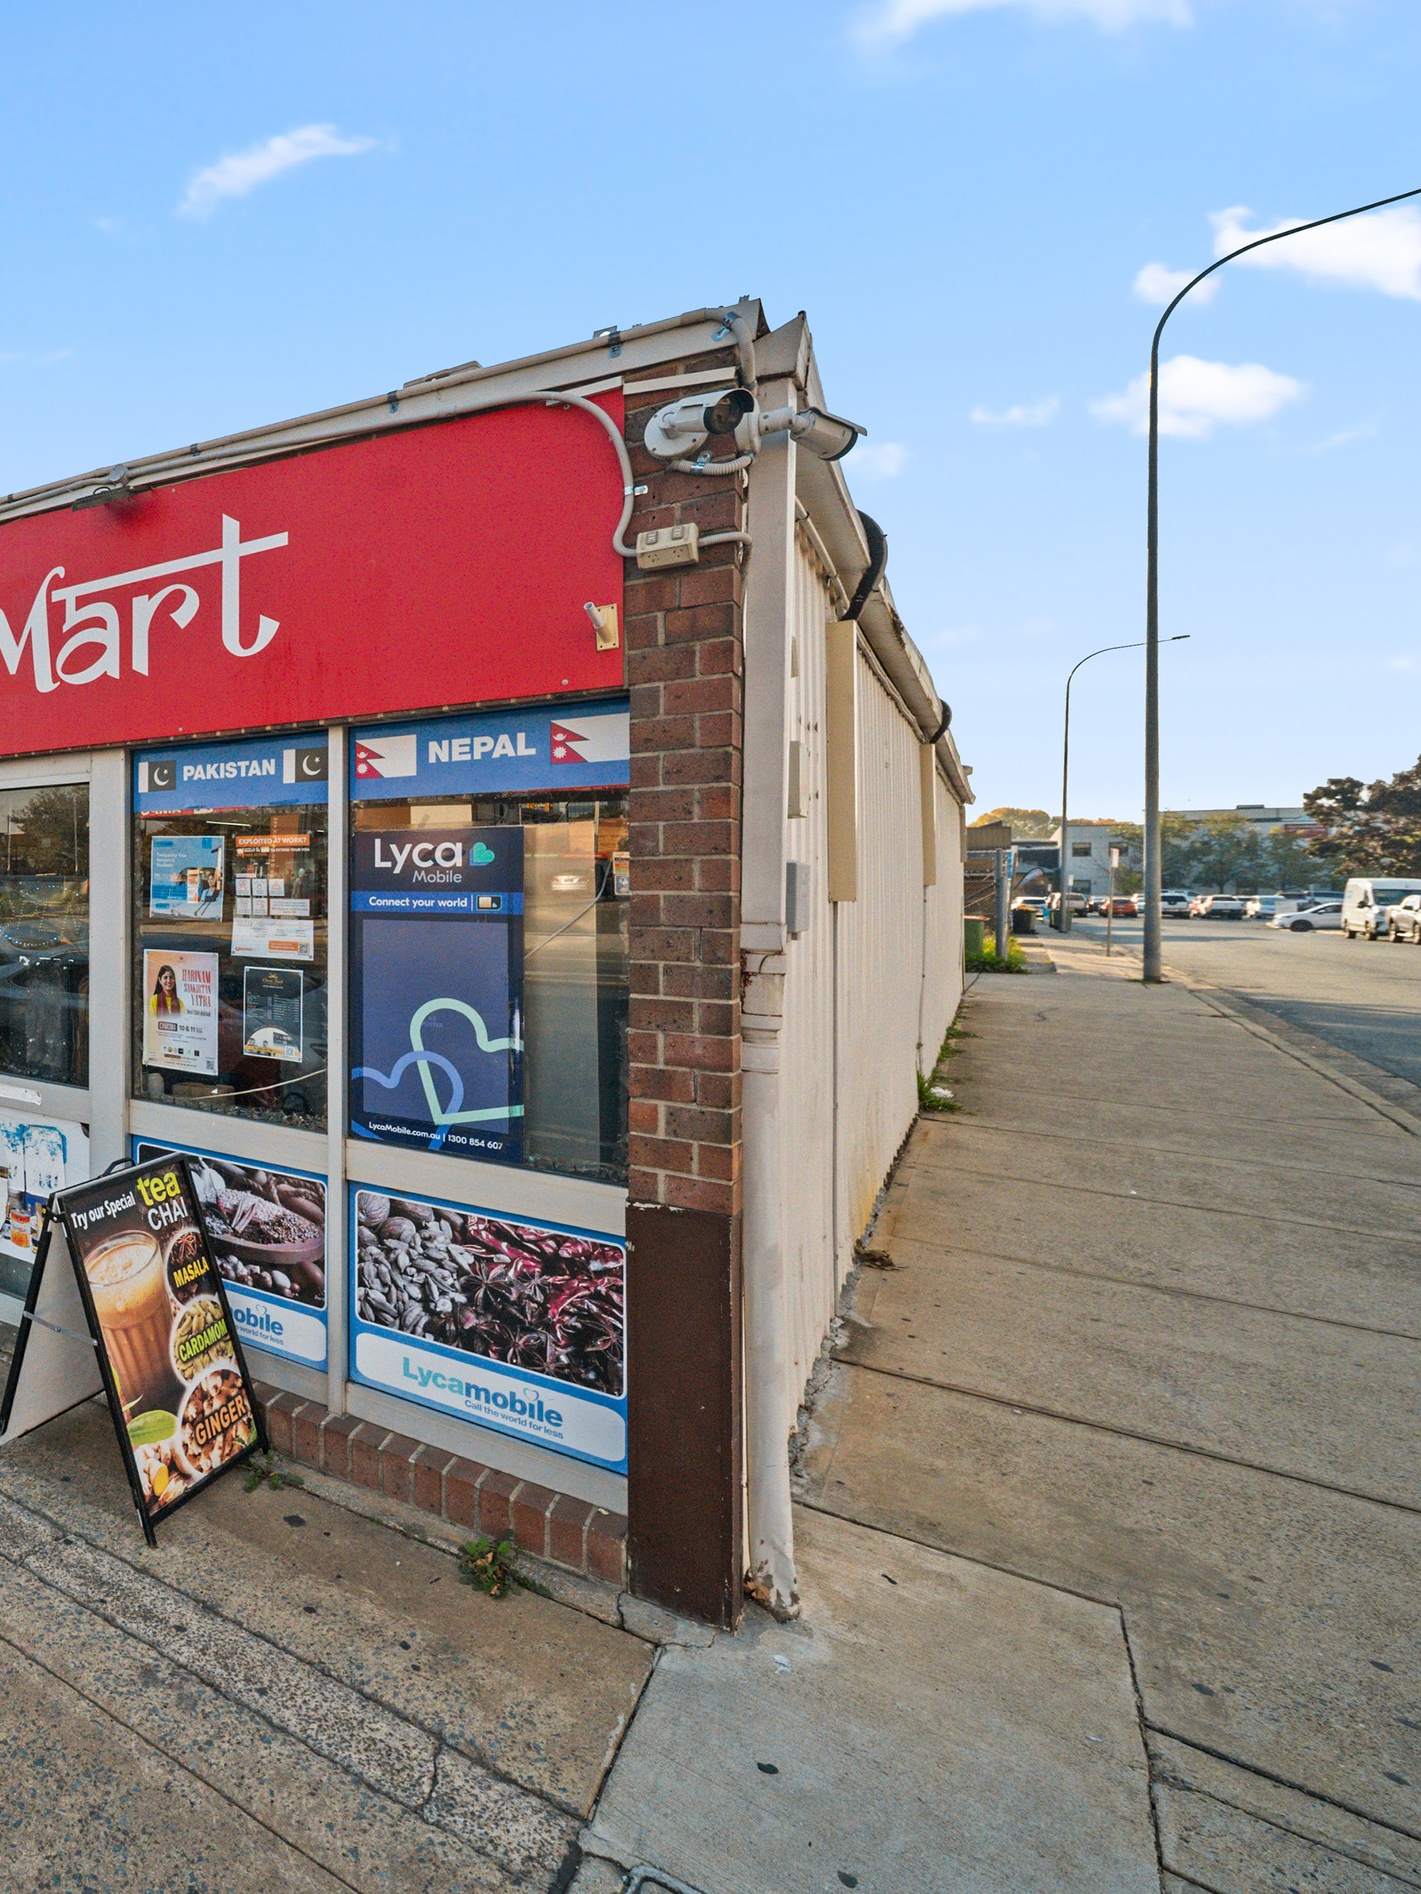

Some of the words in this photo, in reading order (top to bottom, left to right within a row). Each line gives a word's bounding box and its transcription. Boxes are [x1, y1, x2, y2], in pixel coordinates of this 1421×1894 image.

[428, 732, 536, 763] NEPAL
[183, 759, 276, 781] PAKISTAN
[238, 837, 272, 845] EXPLOITED
[282, 836, 307, 844] WORK?
[374, 838, 463, 874] Lyca
[412, 870, 463, 883] Mobile
[369, 896, 410, 906] Connect
[412, 898, 435, 908] your
[437, 897, 468, 907] world
[182, 969, 211, 983] HARINAM
[369, 1121, 441, 1140] LycaMobile.com.au
[448, 1134, 468, 1144] 1300
[469, 1137, 485, 1147] 854
[487, 1141, 503, 1150] 607
[137, 1172, 181, 1207] tea
[70, 1211, 88, 1230] Try
[89, 1206, 105, 1222] our
[105, 1191, 136, 1218] Special
[147, 1197, 189, 1230] CHAI
[173, 1256, 209, 1288] MASALA
[231, 1306, 284, 1336] obile
[240, 1326, 260, 1337] world
[260, 1331, 270, 1340] for
[179, 1318, 228, 1362] CARDAMOM
[403, 1357, 563, 1428] Lycamobile
[195, 1395, 247, 1445] GINGER
[464, 1399, 482, 1411] Call
[483, 1405, 499, 1418] the
[500, 1412, 527, 1427] world
[528, 1420, 542, 1432] for
[543, 1425, 564, 1439] less
